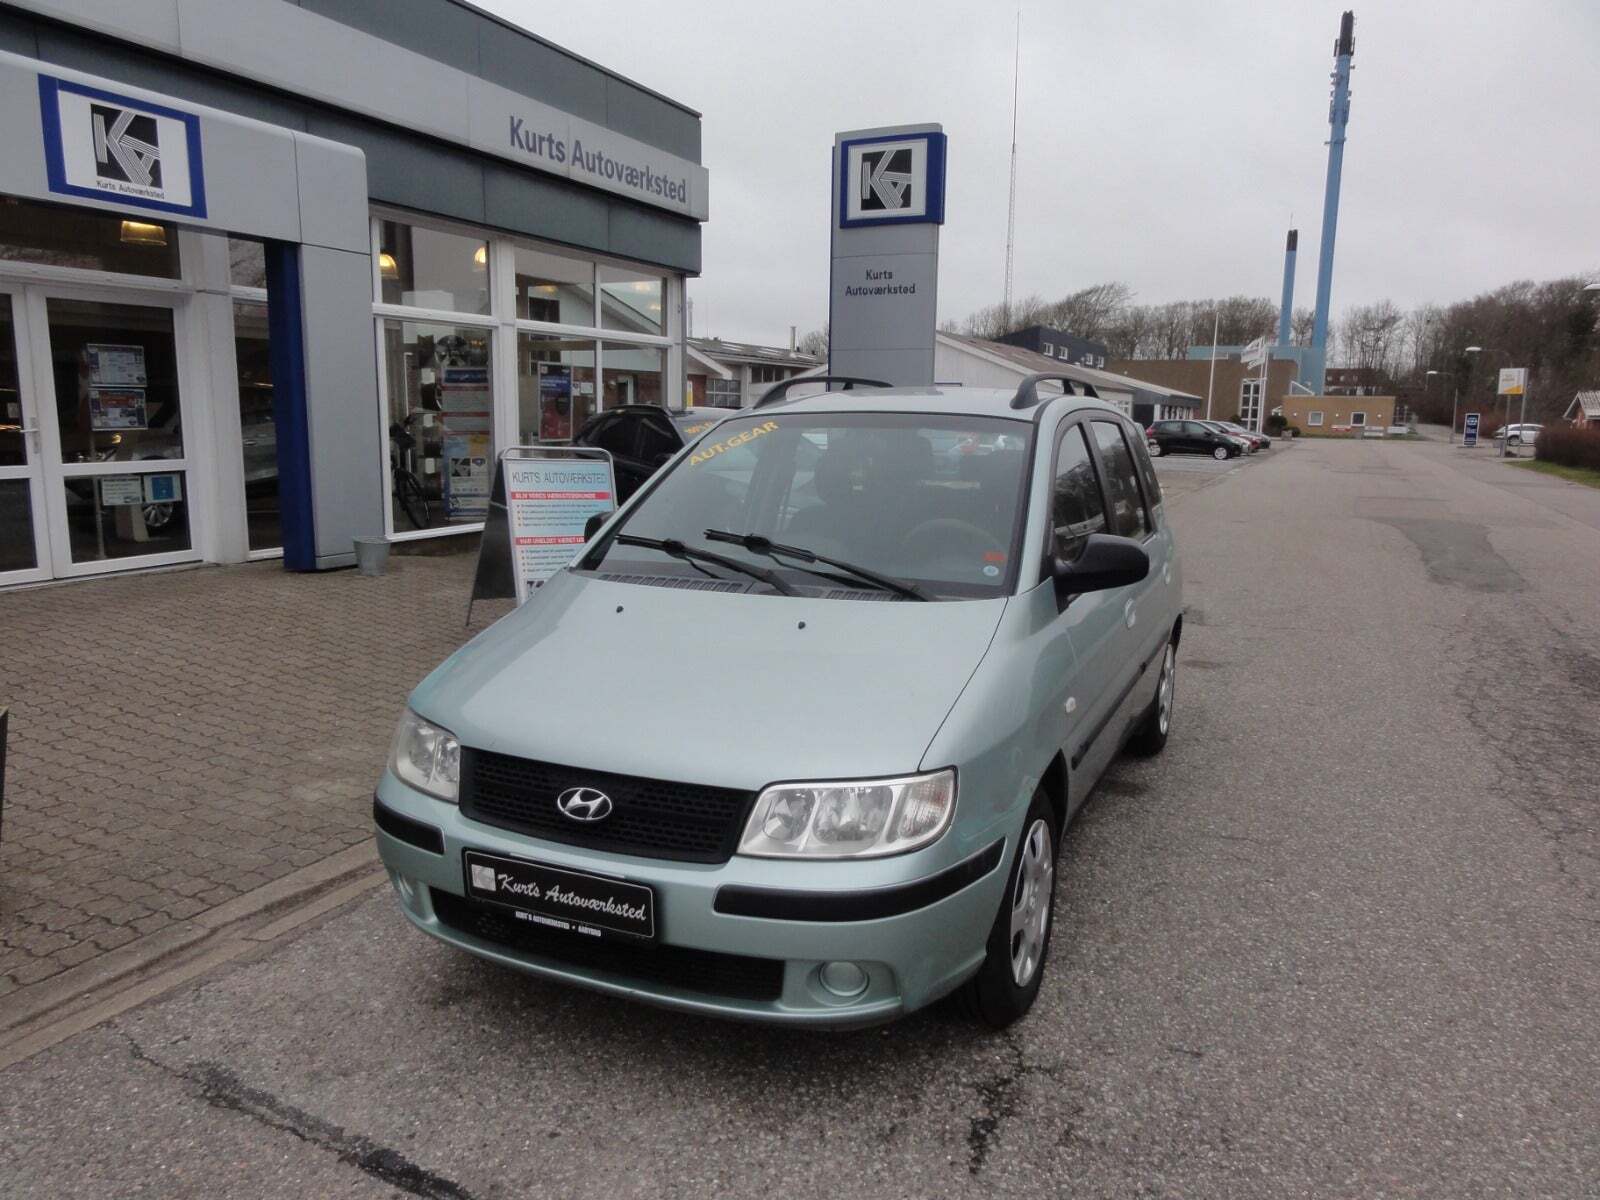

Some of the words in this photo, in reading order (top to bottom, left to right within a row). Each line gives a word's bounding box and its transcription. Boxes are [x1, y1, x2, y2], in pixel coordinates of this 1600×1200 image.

[509, 115, 567, 163] Kurts
[571, 140, 687, 204] Autoværksted
[865, 269, 893, 281] Kurts
[845, 283, 916, 297] Autoværksted
[512, 471, 541, 484] KURTS
[544, 885, 647, 921] Autoværksted
